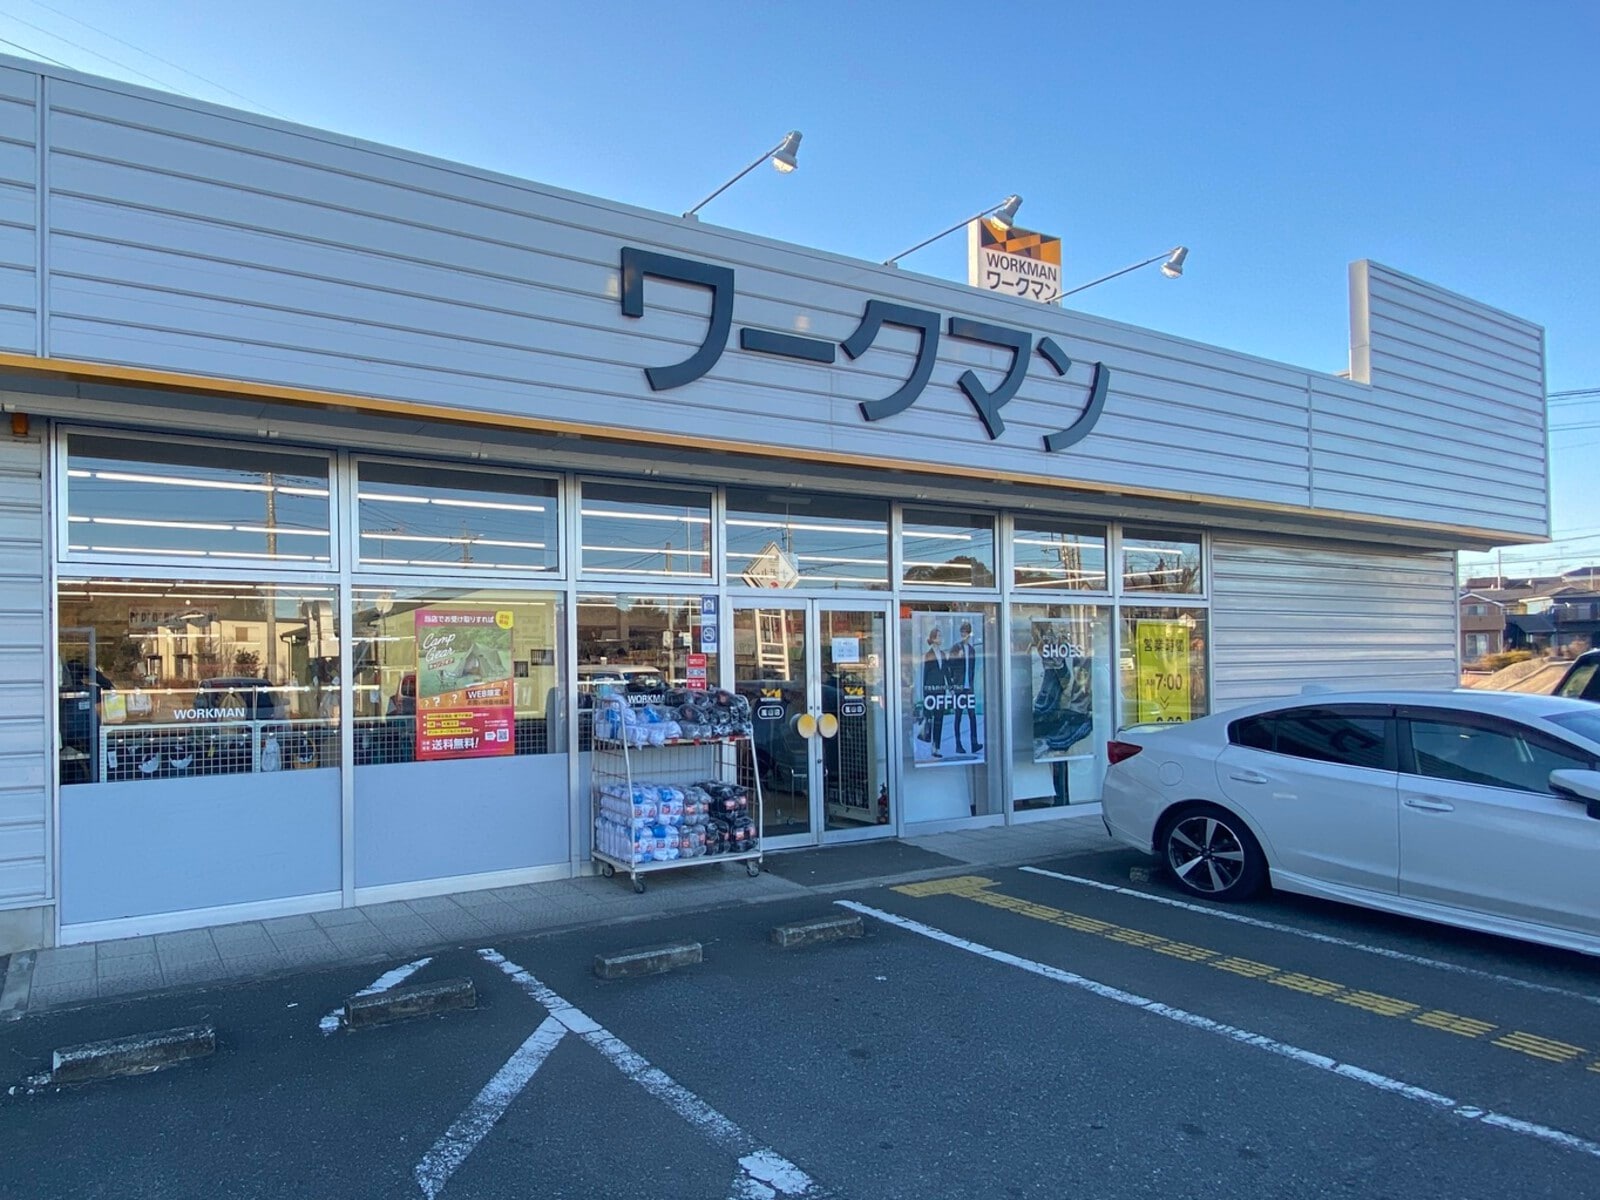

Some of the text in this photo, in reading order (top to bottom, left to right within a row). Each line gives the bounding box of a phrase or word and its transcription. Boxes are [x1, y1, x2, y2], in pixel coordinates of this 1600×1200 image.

[986, 252, 1057, 282] WORKMAN
[986, 270, 1058, 301] ワークマン
[620, 246, 1111, 453] ワークマン
[422, 633, 456, 650] Camp
[425, 647, 456, 663] Gear
[1042, 643, 1085, 658] SHOES
[1155, 673, 1183, 691] 7:00
[627, 693, 666, 704] WORKMA
[923, 694, 976, 711] OFFICE
[173, 707, 246, 720] WORKMAN
